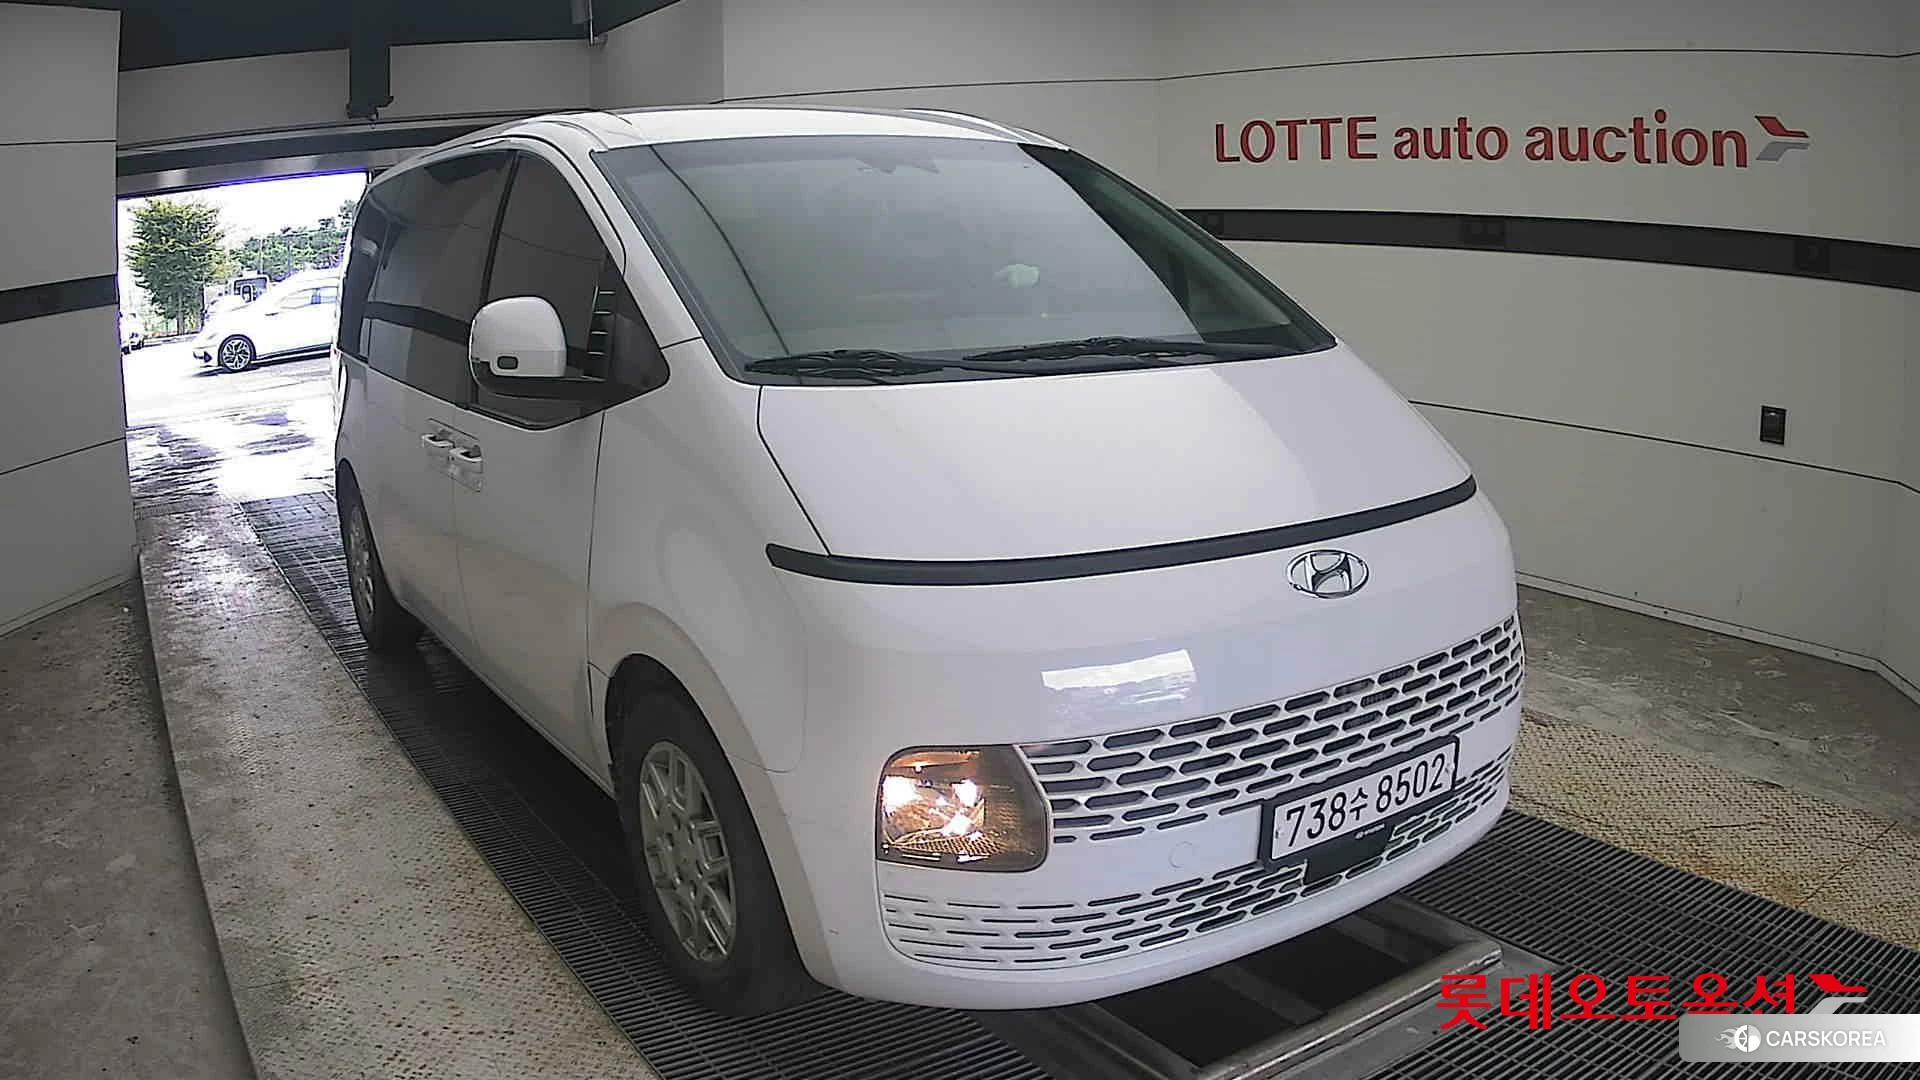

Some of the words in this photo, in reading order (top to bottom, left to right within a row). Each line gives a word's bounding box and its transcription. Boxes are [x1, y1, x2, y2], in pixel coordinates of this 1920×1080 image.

[1214, 116, 1378, 164] LOTTE
[1393, 116, 1510, 161] auto
[1524, 109, 1749, 168] auction
[1375, 752, 1446, 814] 8502
